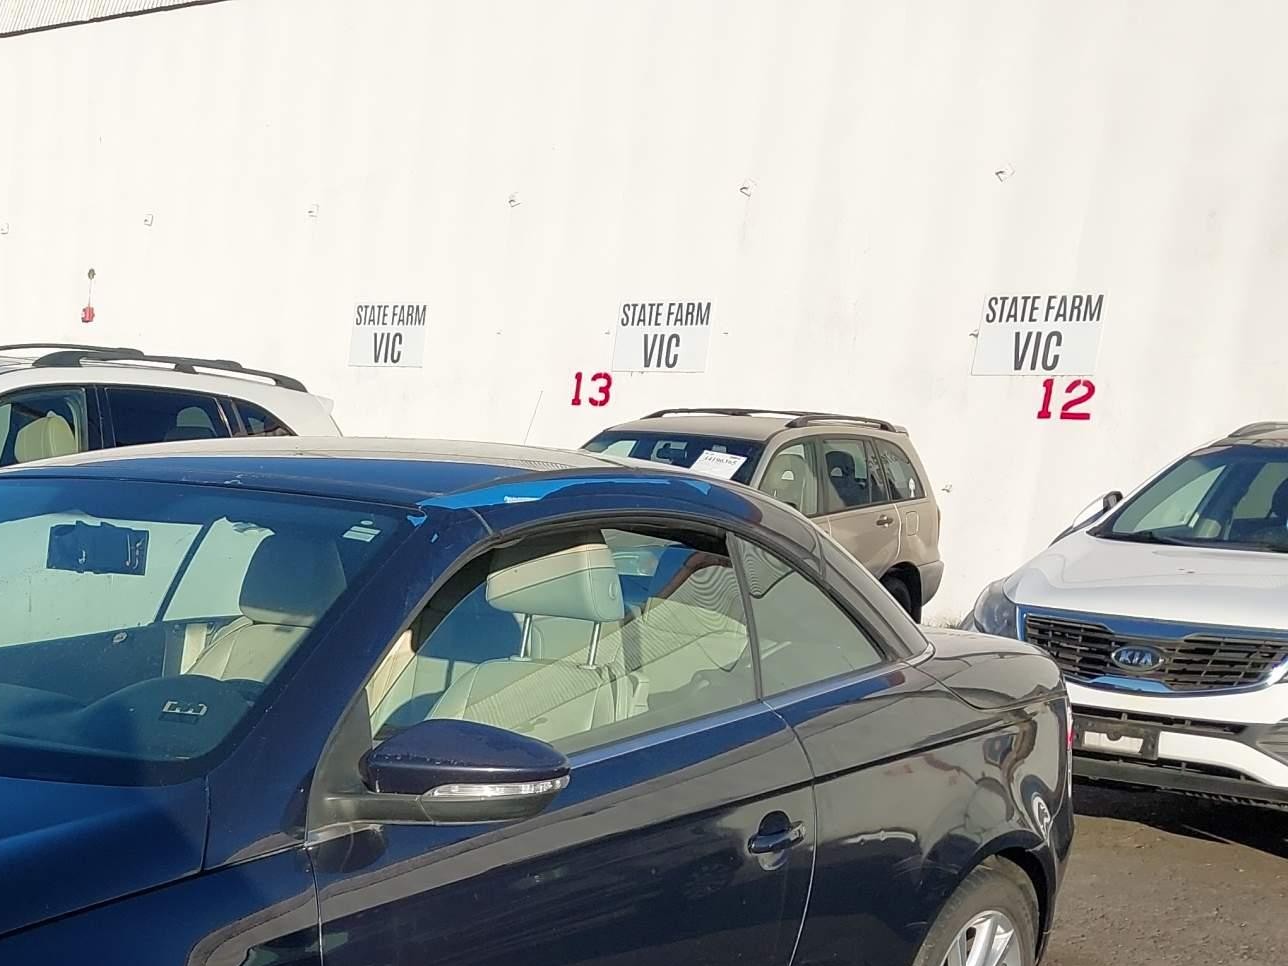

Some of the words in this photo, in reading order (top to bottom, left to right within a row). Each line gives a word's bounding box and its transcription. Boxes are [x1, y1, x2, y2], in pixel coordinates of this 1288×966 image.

[356, 304, 390, 326] STATE
[391, 304, 427, 326] FARM
[620, 303, 663, 327] STATE
[666, 302, 711, 326] FARM
[985, 295, 1041, 323] STATE
[1044, 294, 1104, 322] FARM
[373, 332, 403, 363] VIC
[643, 333, 681, 368] VIC
[1013, 330, 1063, 371] VIC
[571, 371, 612, 407] 13
[1036, 378, 1096, 420] 12
[1119, 650, 1153, 666] KIA
